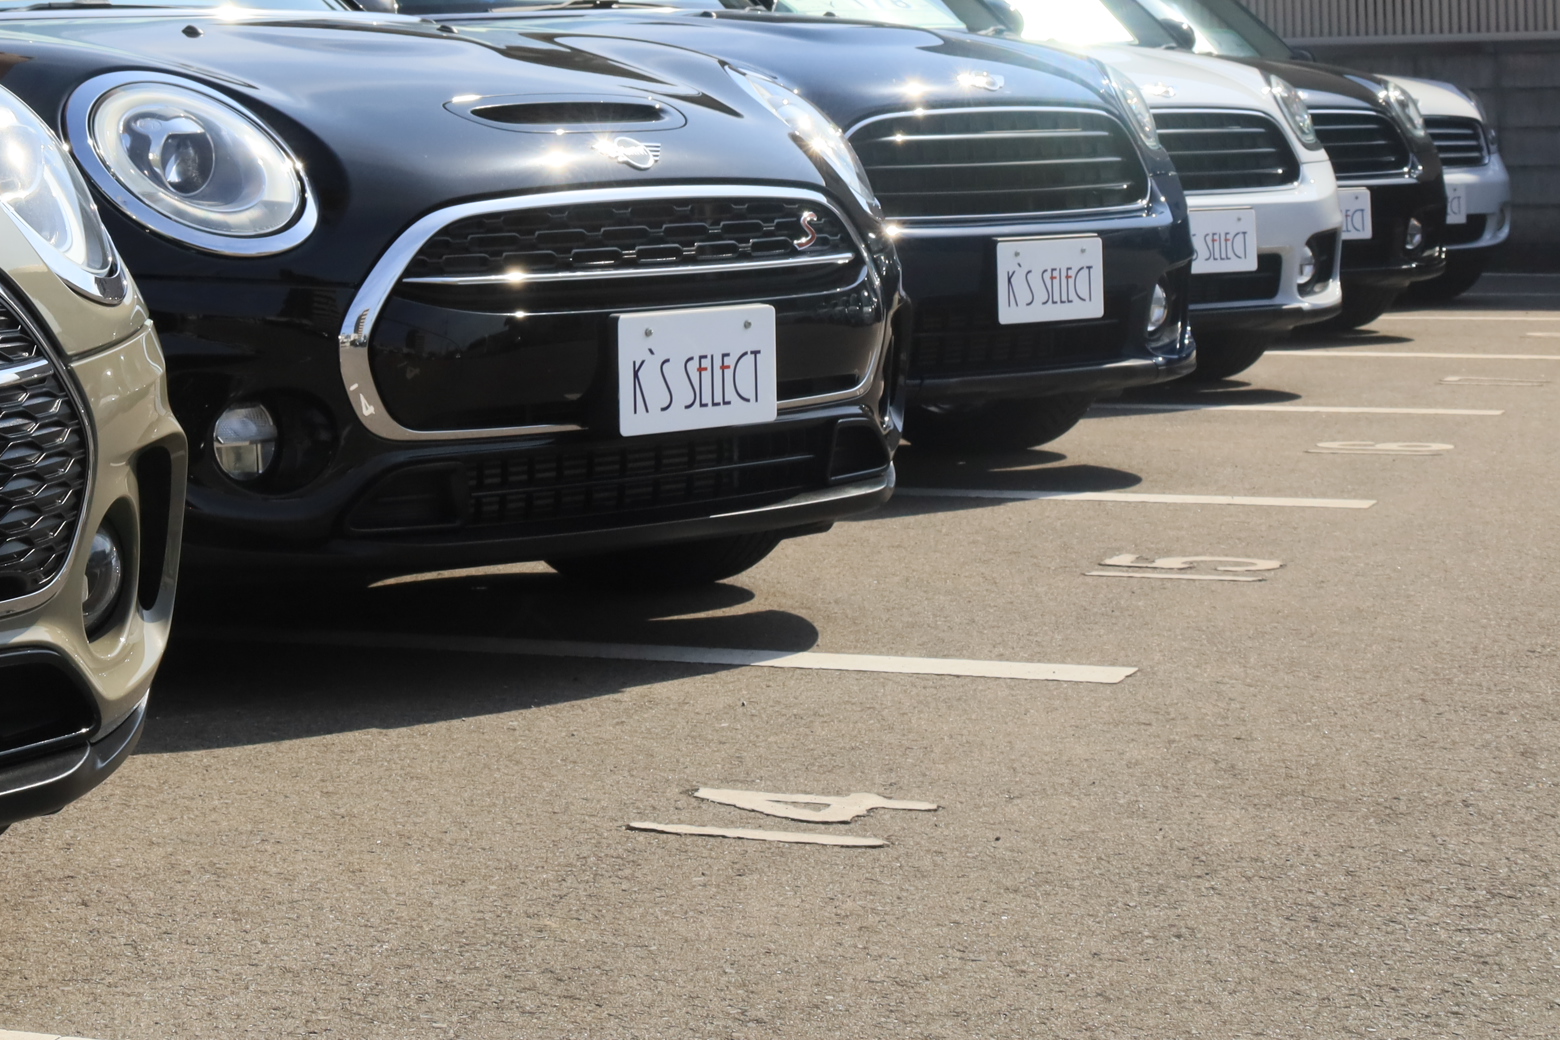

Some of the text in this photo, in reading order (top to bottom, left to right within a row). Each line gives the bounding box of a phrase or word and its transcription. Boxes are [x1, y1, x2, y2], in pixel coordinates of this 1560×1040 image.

[1203, 231, 1248, 262] SELECT
[1041, 265, 1093, 306] SELECT
[683, 349, 762, 410] SELECT
[1083, 552, 1286, 583] 15
[627, 786, 941, 848] 14
